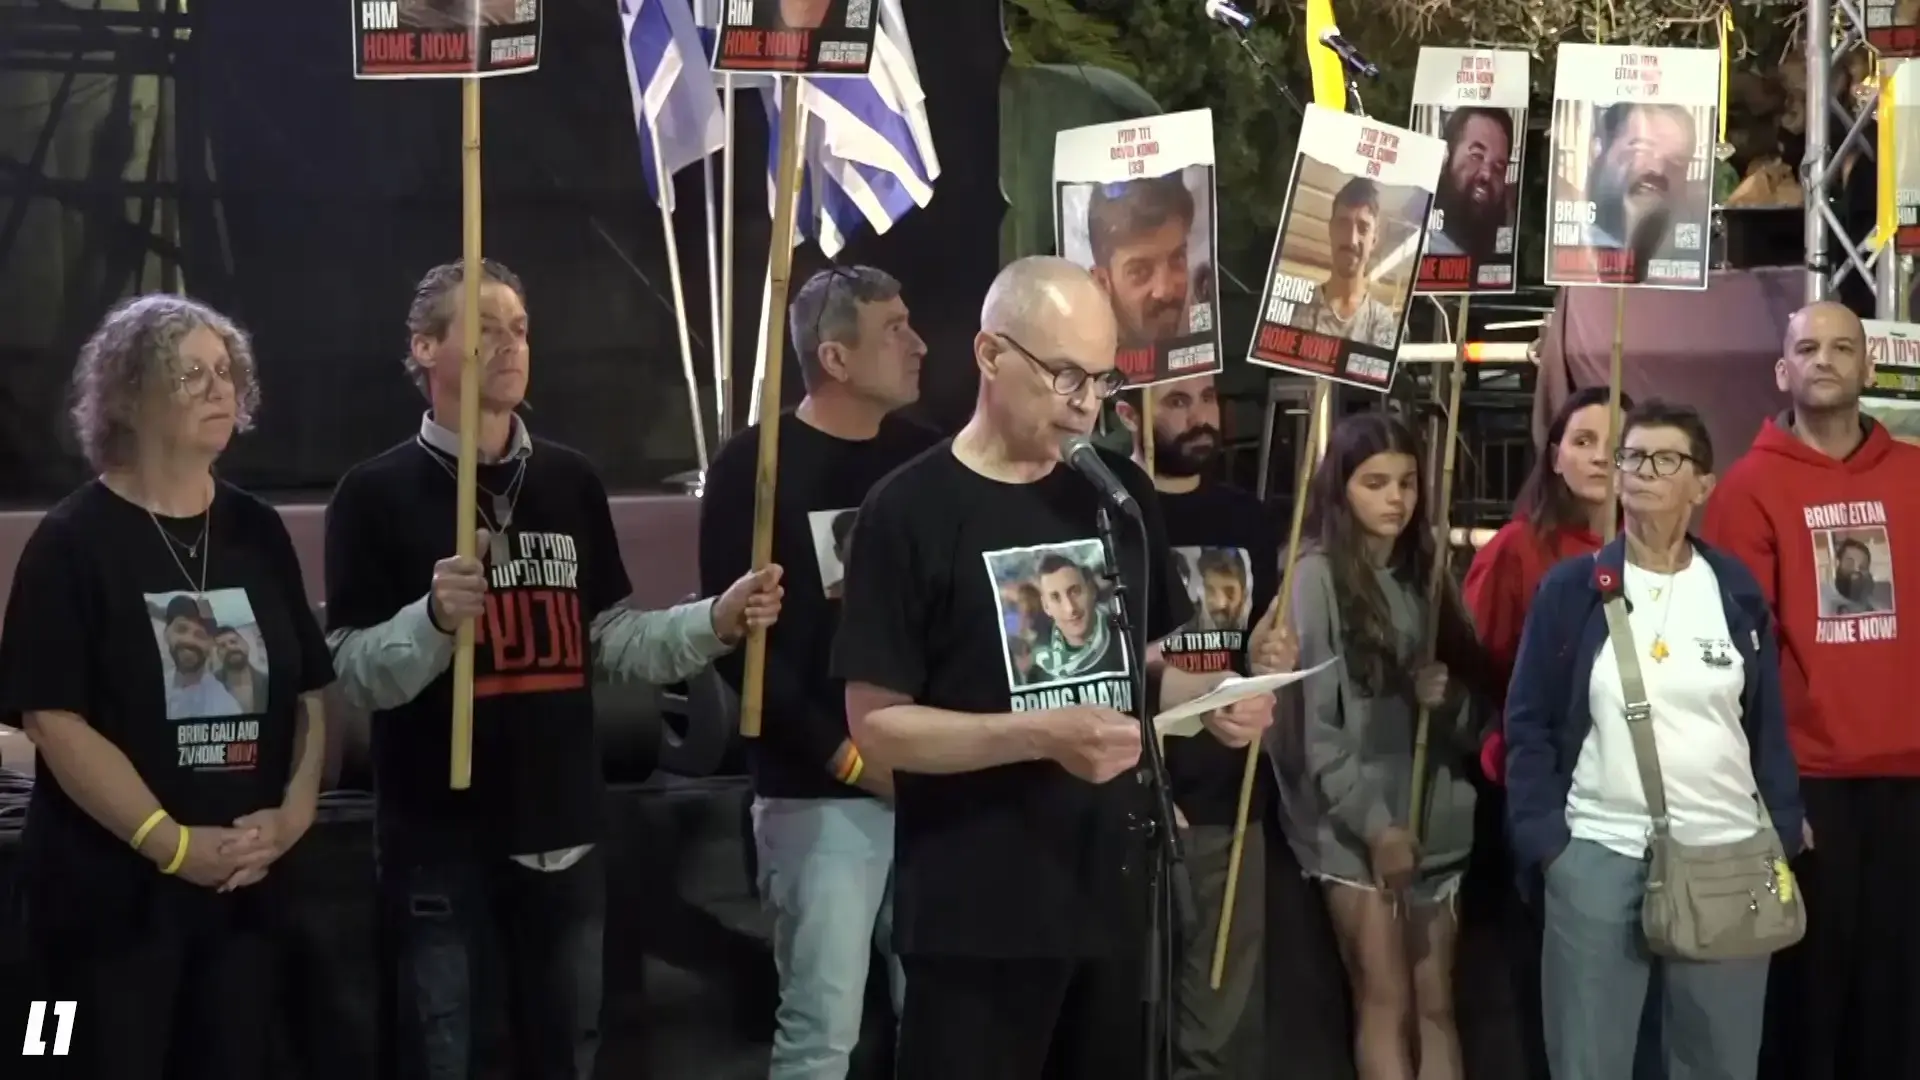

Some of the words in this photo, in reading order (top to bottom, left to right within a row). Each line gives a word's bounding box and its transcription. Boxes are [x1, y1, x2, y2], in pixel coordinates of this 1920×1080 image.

[362, 1, 398, 29] HIM
[363, 33, 416, 61] HOME
[420, 33, 475, 61] NOW!
[725, 31, 763, 56] HOME
[764, 31, 809, 57] NOW!
[1272, 272, 1314, 304] BRING
[1265, 299, 1295, 326] HIM
[1259, 324, 1299, 354] HOME
[1299, 336, 1341, 364] NOW!
[1803, 502, 1848, 528] BRING
[1848, 500, 1887, 524] EITAN
[518, 531, 578, 561] מחזירים
[543, 560, 578, 590] אותם
[1816, 619, 1858, 643] HOME
[1858, 615, 1898, 641] NOW!
[211, 721, 236, 742] GALI
